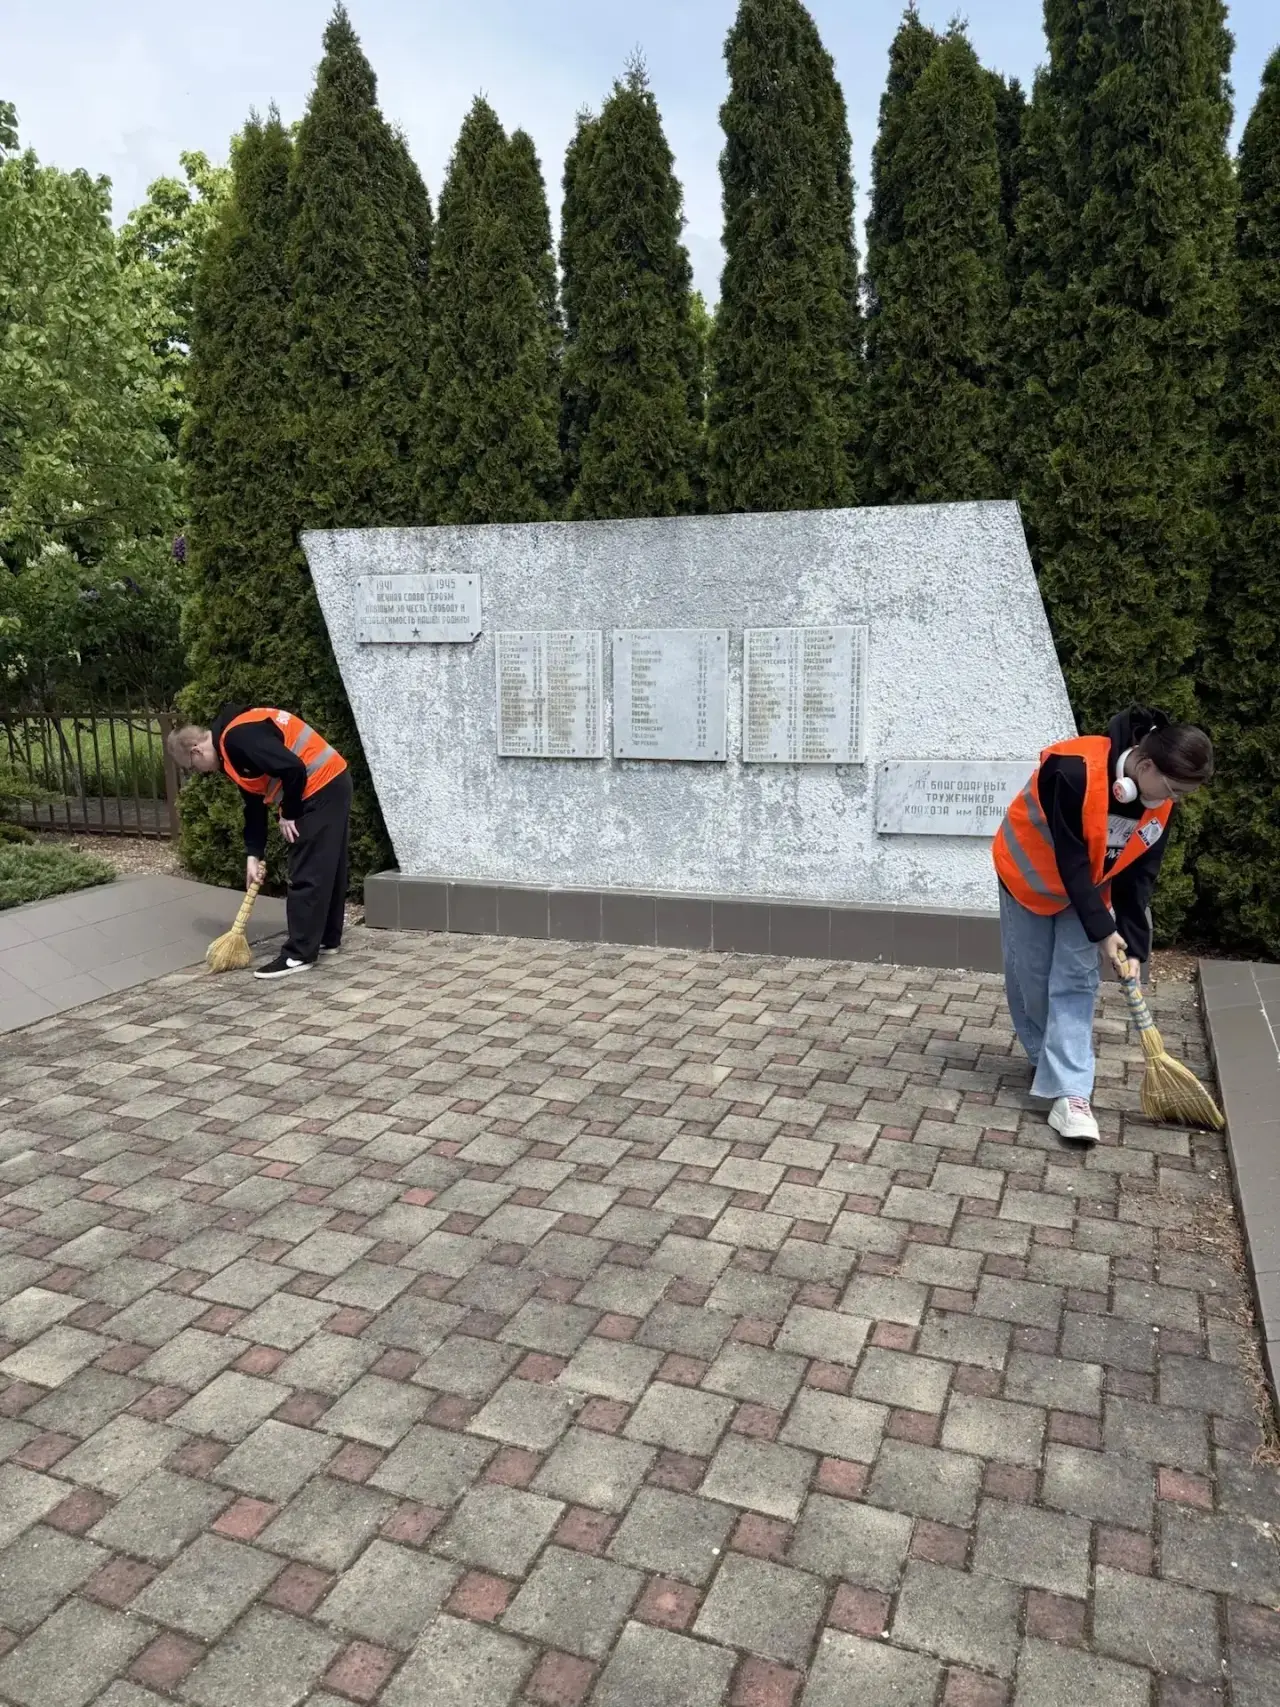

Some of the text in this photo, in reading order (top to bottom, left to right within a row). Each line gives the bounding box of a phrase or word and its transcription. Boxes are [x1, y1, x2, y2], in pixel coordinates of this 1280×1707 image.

[376, 578, 456, 590] 1941 1945
[404, 592, 425, 601] СЛАВА
[426, 592, 455, 601] ГЕРОЯМ
[406, 604, 427, 613] ЧЕСТЬ
[429, 604, 458, 613] СВОБОДУ
[930, 780, 1007, 791] БЛАГОДАРНЫХ
[926, 793, 995, 804] ТРУЖЕНИКОВ
[904, 805, 949, 816] КОЛХОЗА
